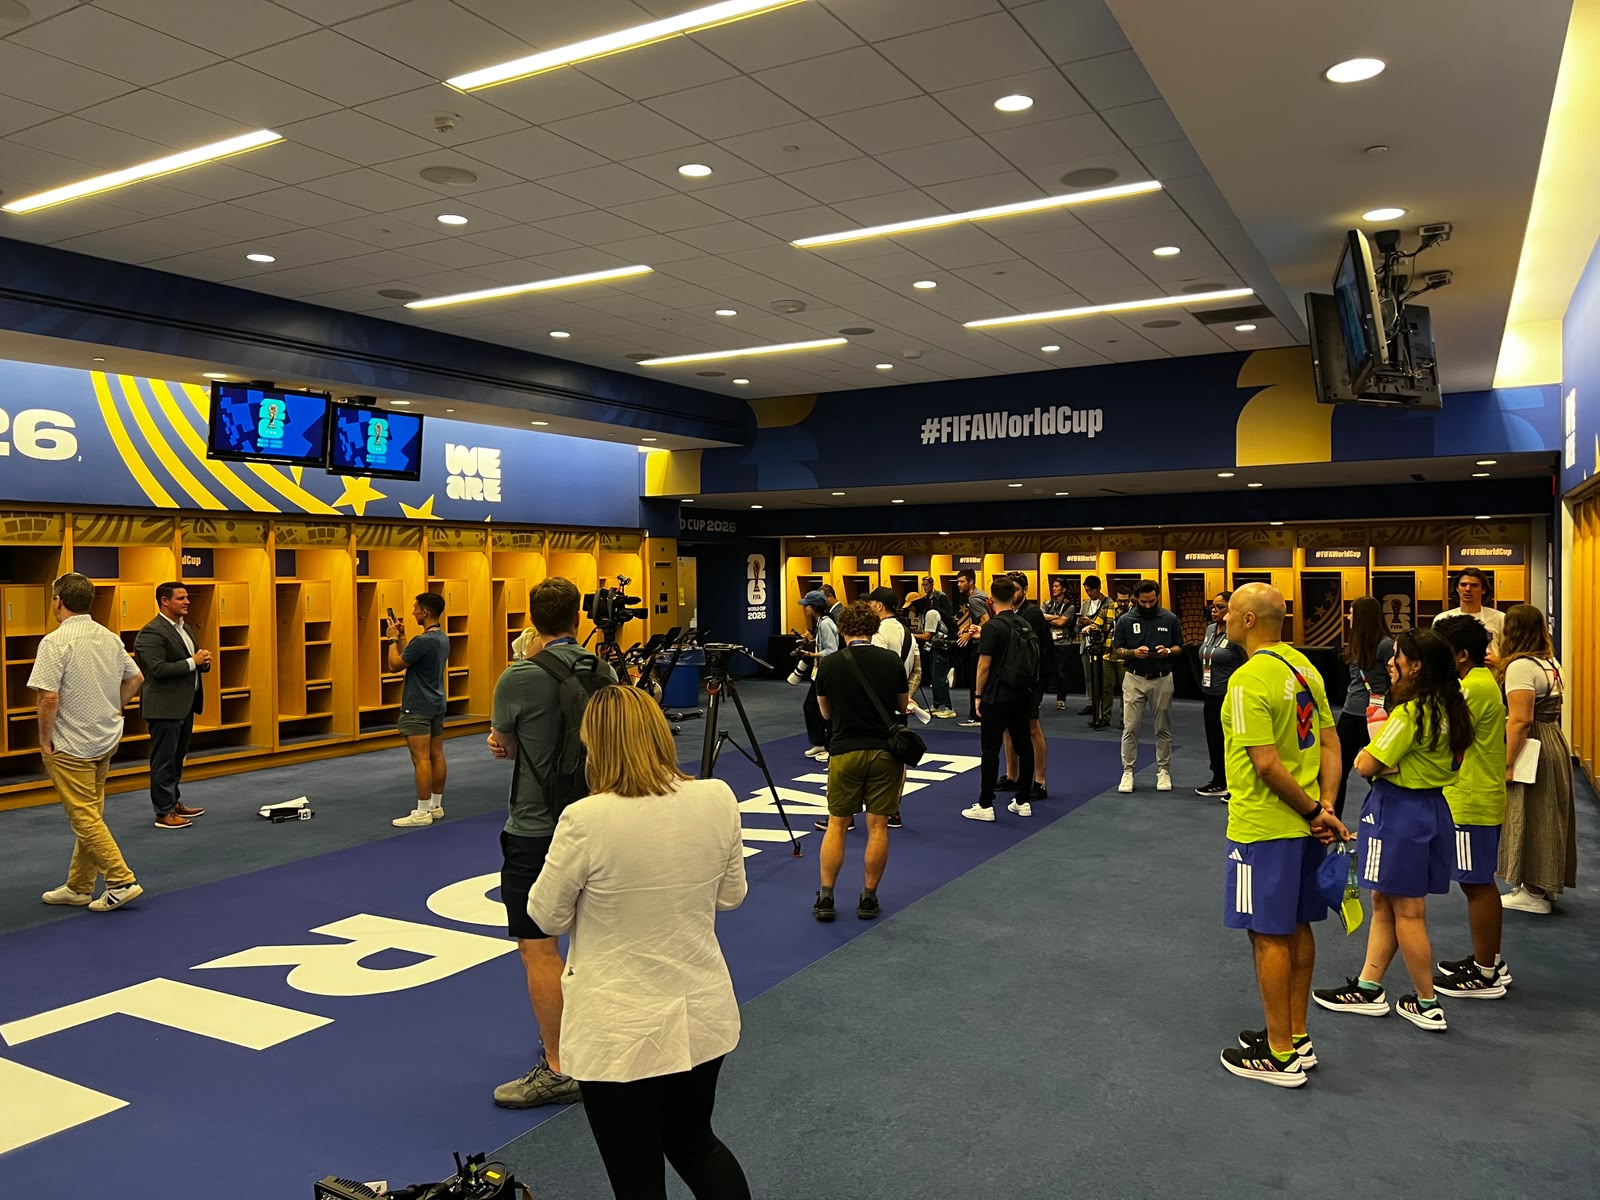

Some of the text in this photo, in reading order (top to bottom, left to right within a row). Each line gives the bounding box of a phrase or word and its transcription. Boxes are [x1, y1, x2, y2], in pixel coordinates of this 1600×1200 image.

[0, 408, 78, 460] 6
[921, 406, 1103, 446] #FIFAWorldCup
[445, 443, 501, 479] WE
[687, 519, 706, 531] CUP
[707, 520, 737, 533] 2026
[748, 612, 767, 620] 2026
